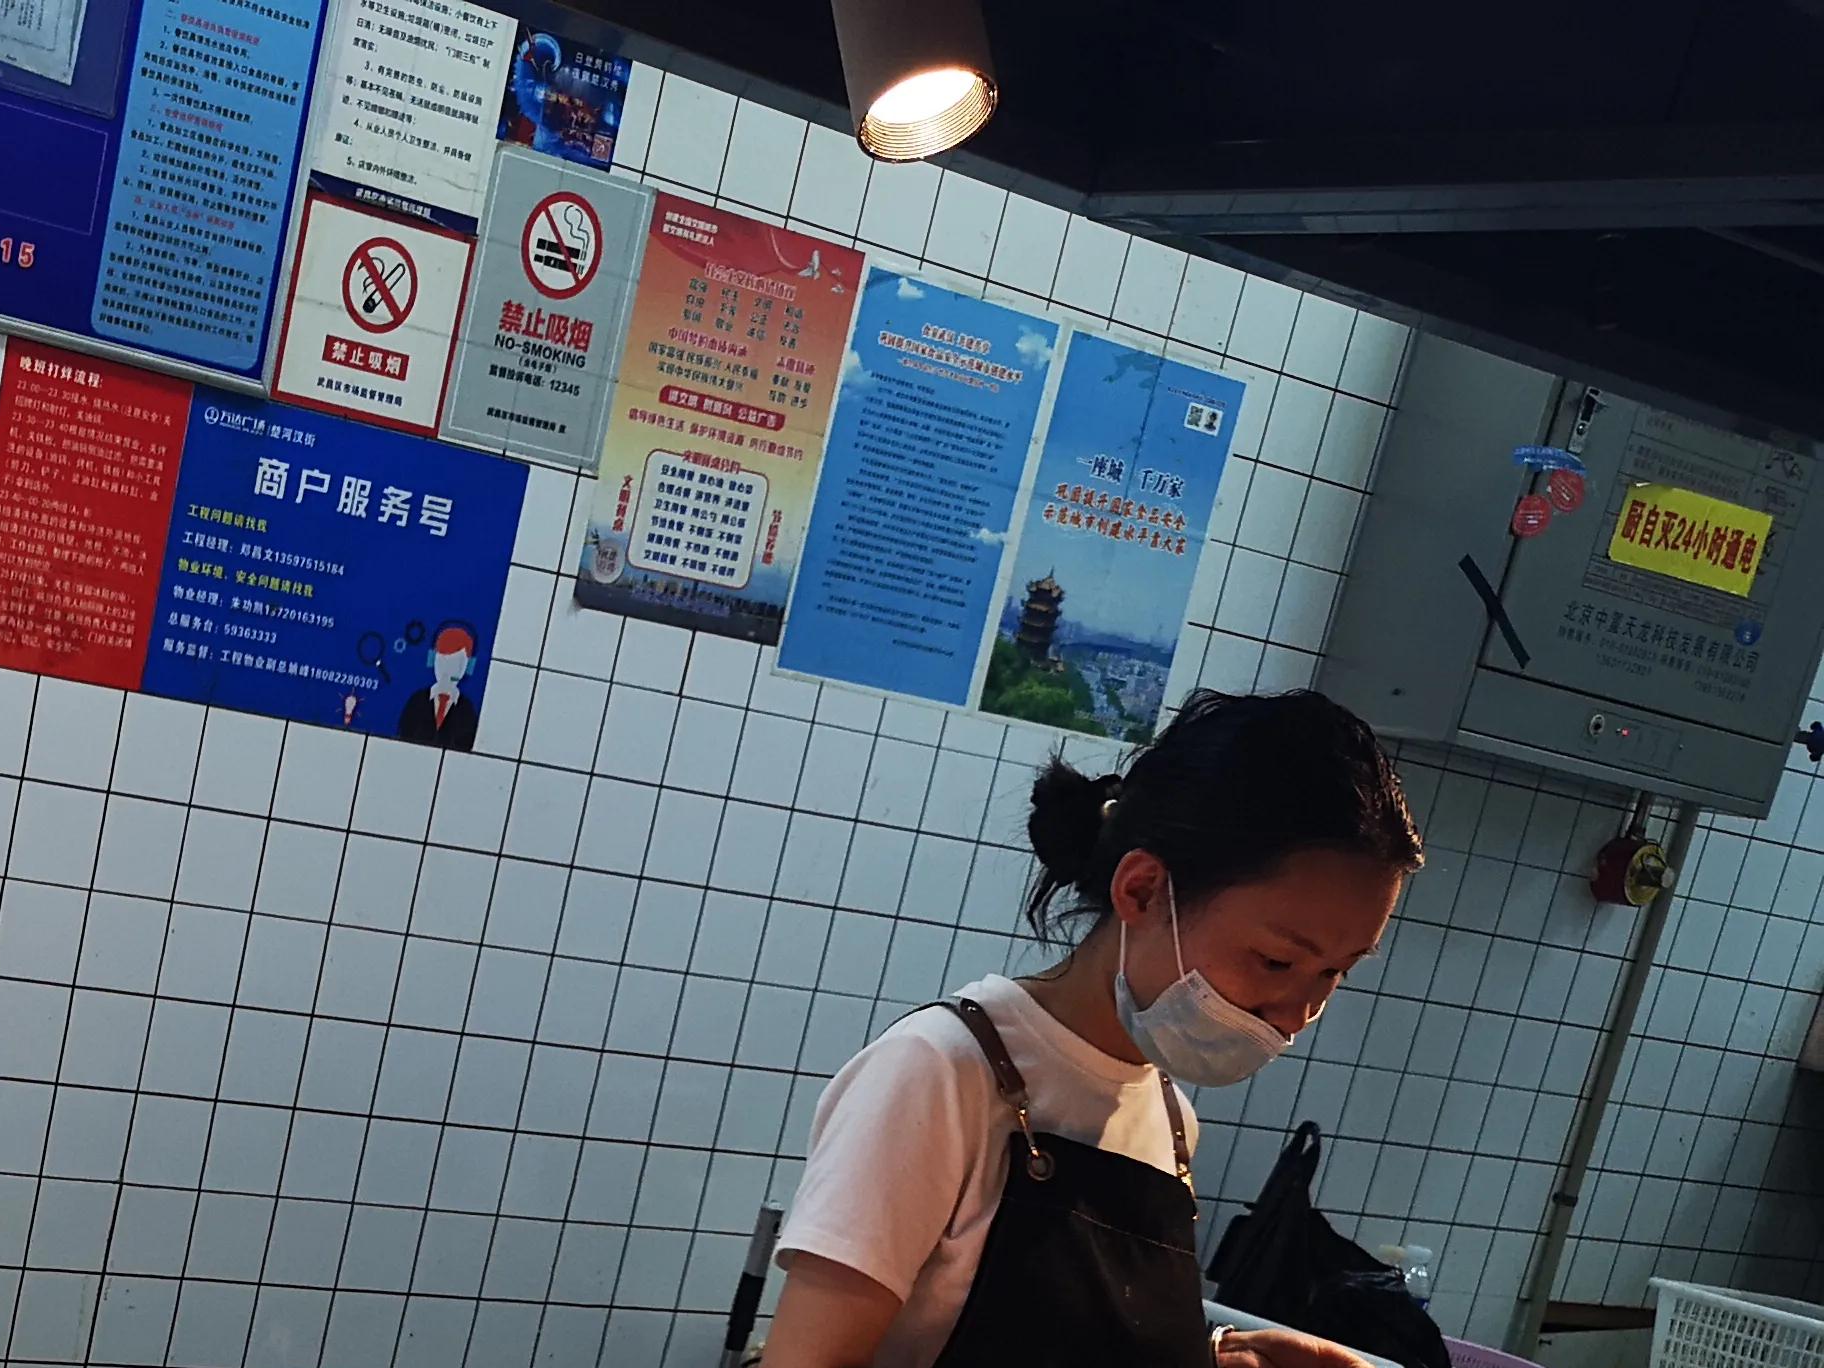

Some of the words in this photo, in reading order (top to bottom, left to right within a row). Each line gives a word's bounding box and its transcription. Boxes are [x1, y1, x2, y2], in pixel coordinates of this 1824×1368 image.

[498, 299, 594, 353] 禁止吸烟
[331, 341, 403, 377] 禁止吸烟
[317, 376, 403, 407] 武昌区市场监督管理局
[270, 424, 317, 448] 楚河汉街
[1077, 453, 1125, 484] 一座城
[1138, 467, 1186, 499] 千万家
[253, 456, 453, 537] 商户服务号
[187, 503, 268, 533] 工程问题请找我
